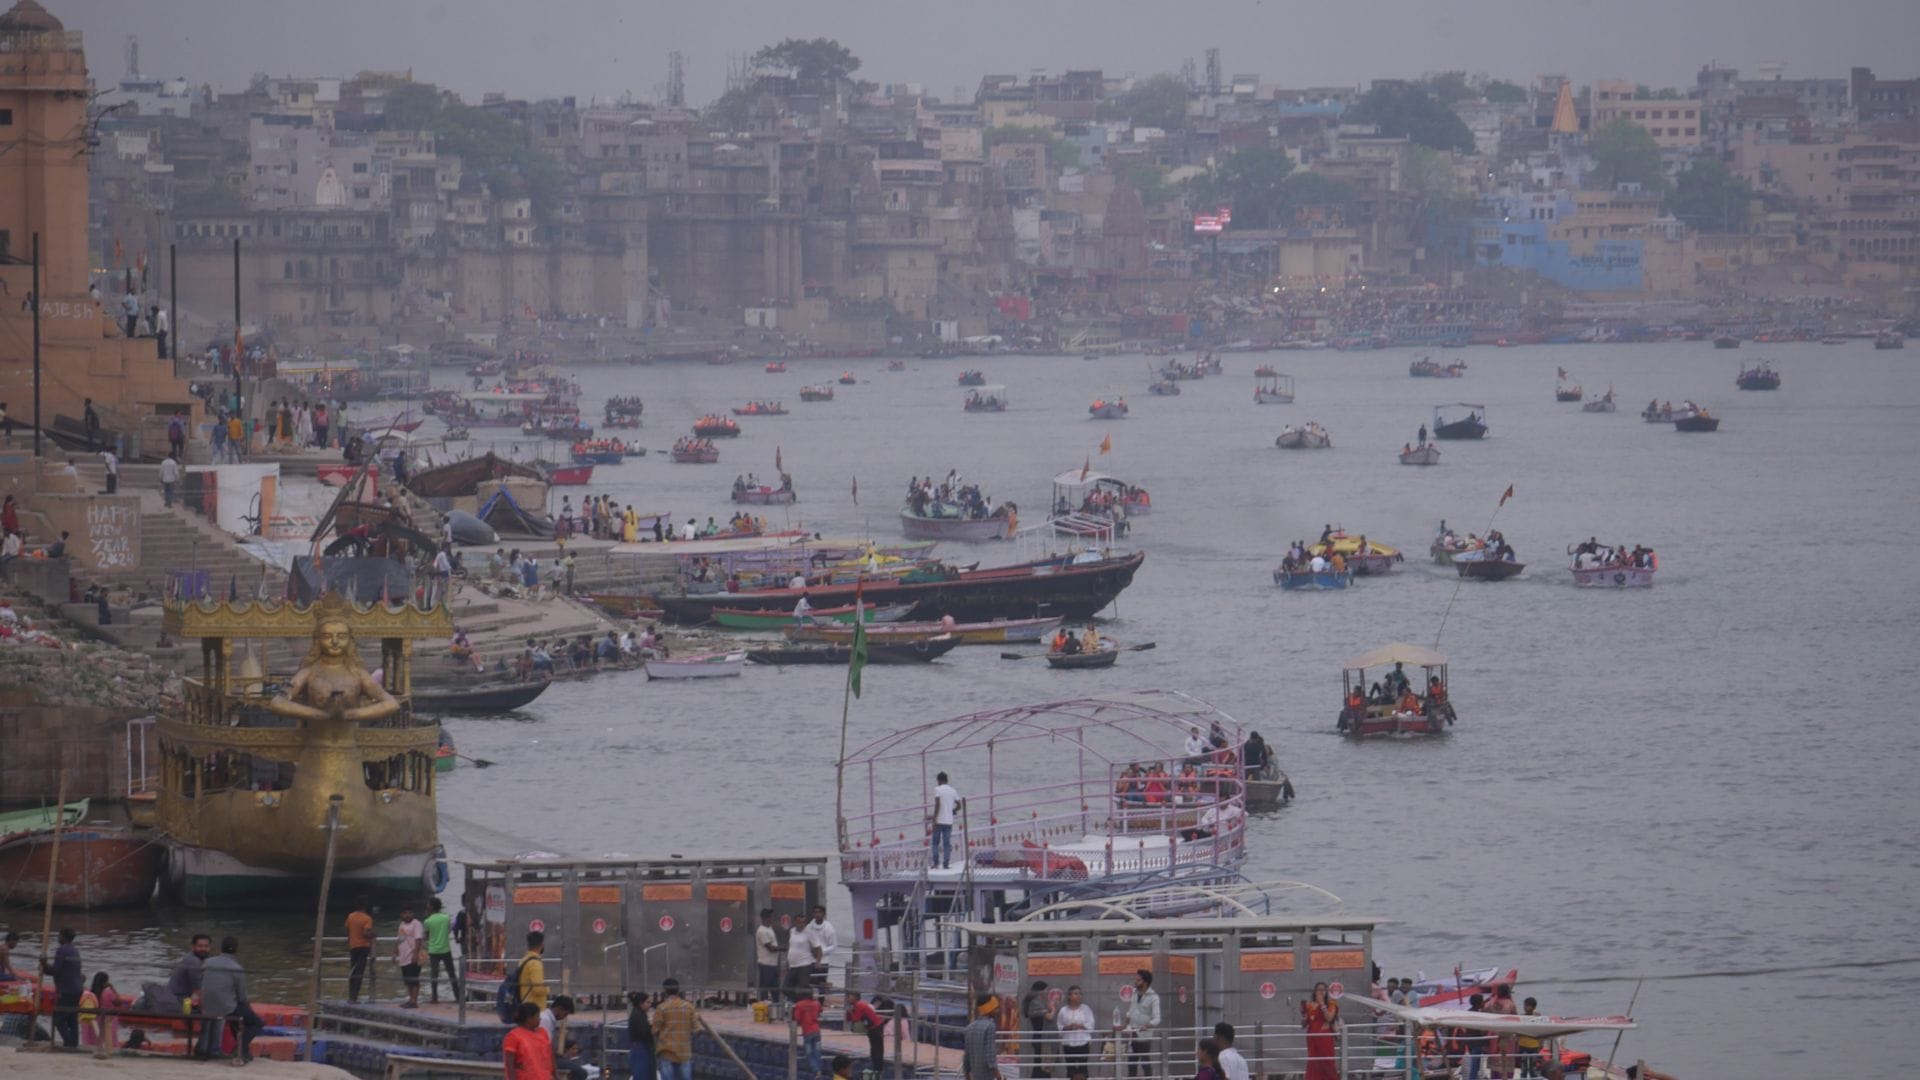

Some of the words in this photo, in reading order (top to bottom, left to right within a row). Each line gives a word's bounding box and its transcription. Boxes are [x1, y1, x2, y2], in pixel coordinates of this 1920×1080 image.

[87, 504, 138, 528] HAPPY
[89, 524, 122, 538] NEW
[90, 536, 130, 554] YEAR
